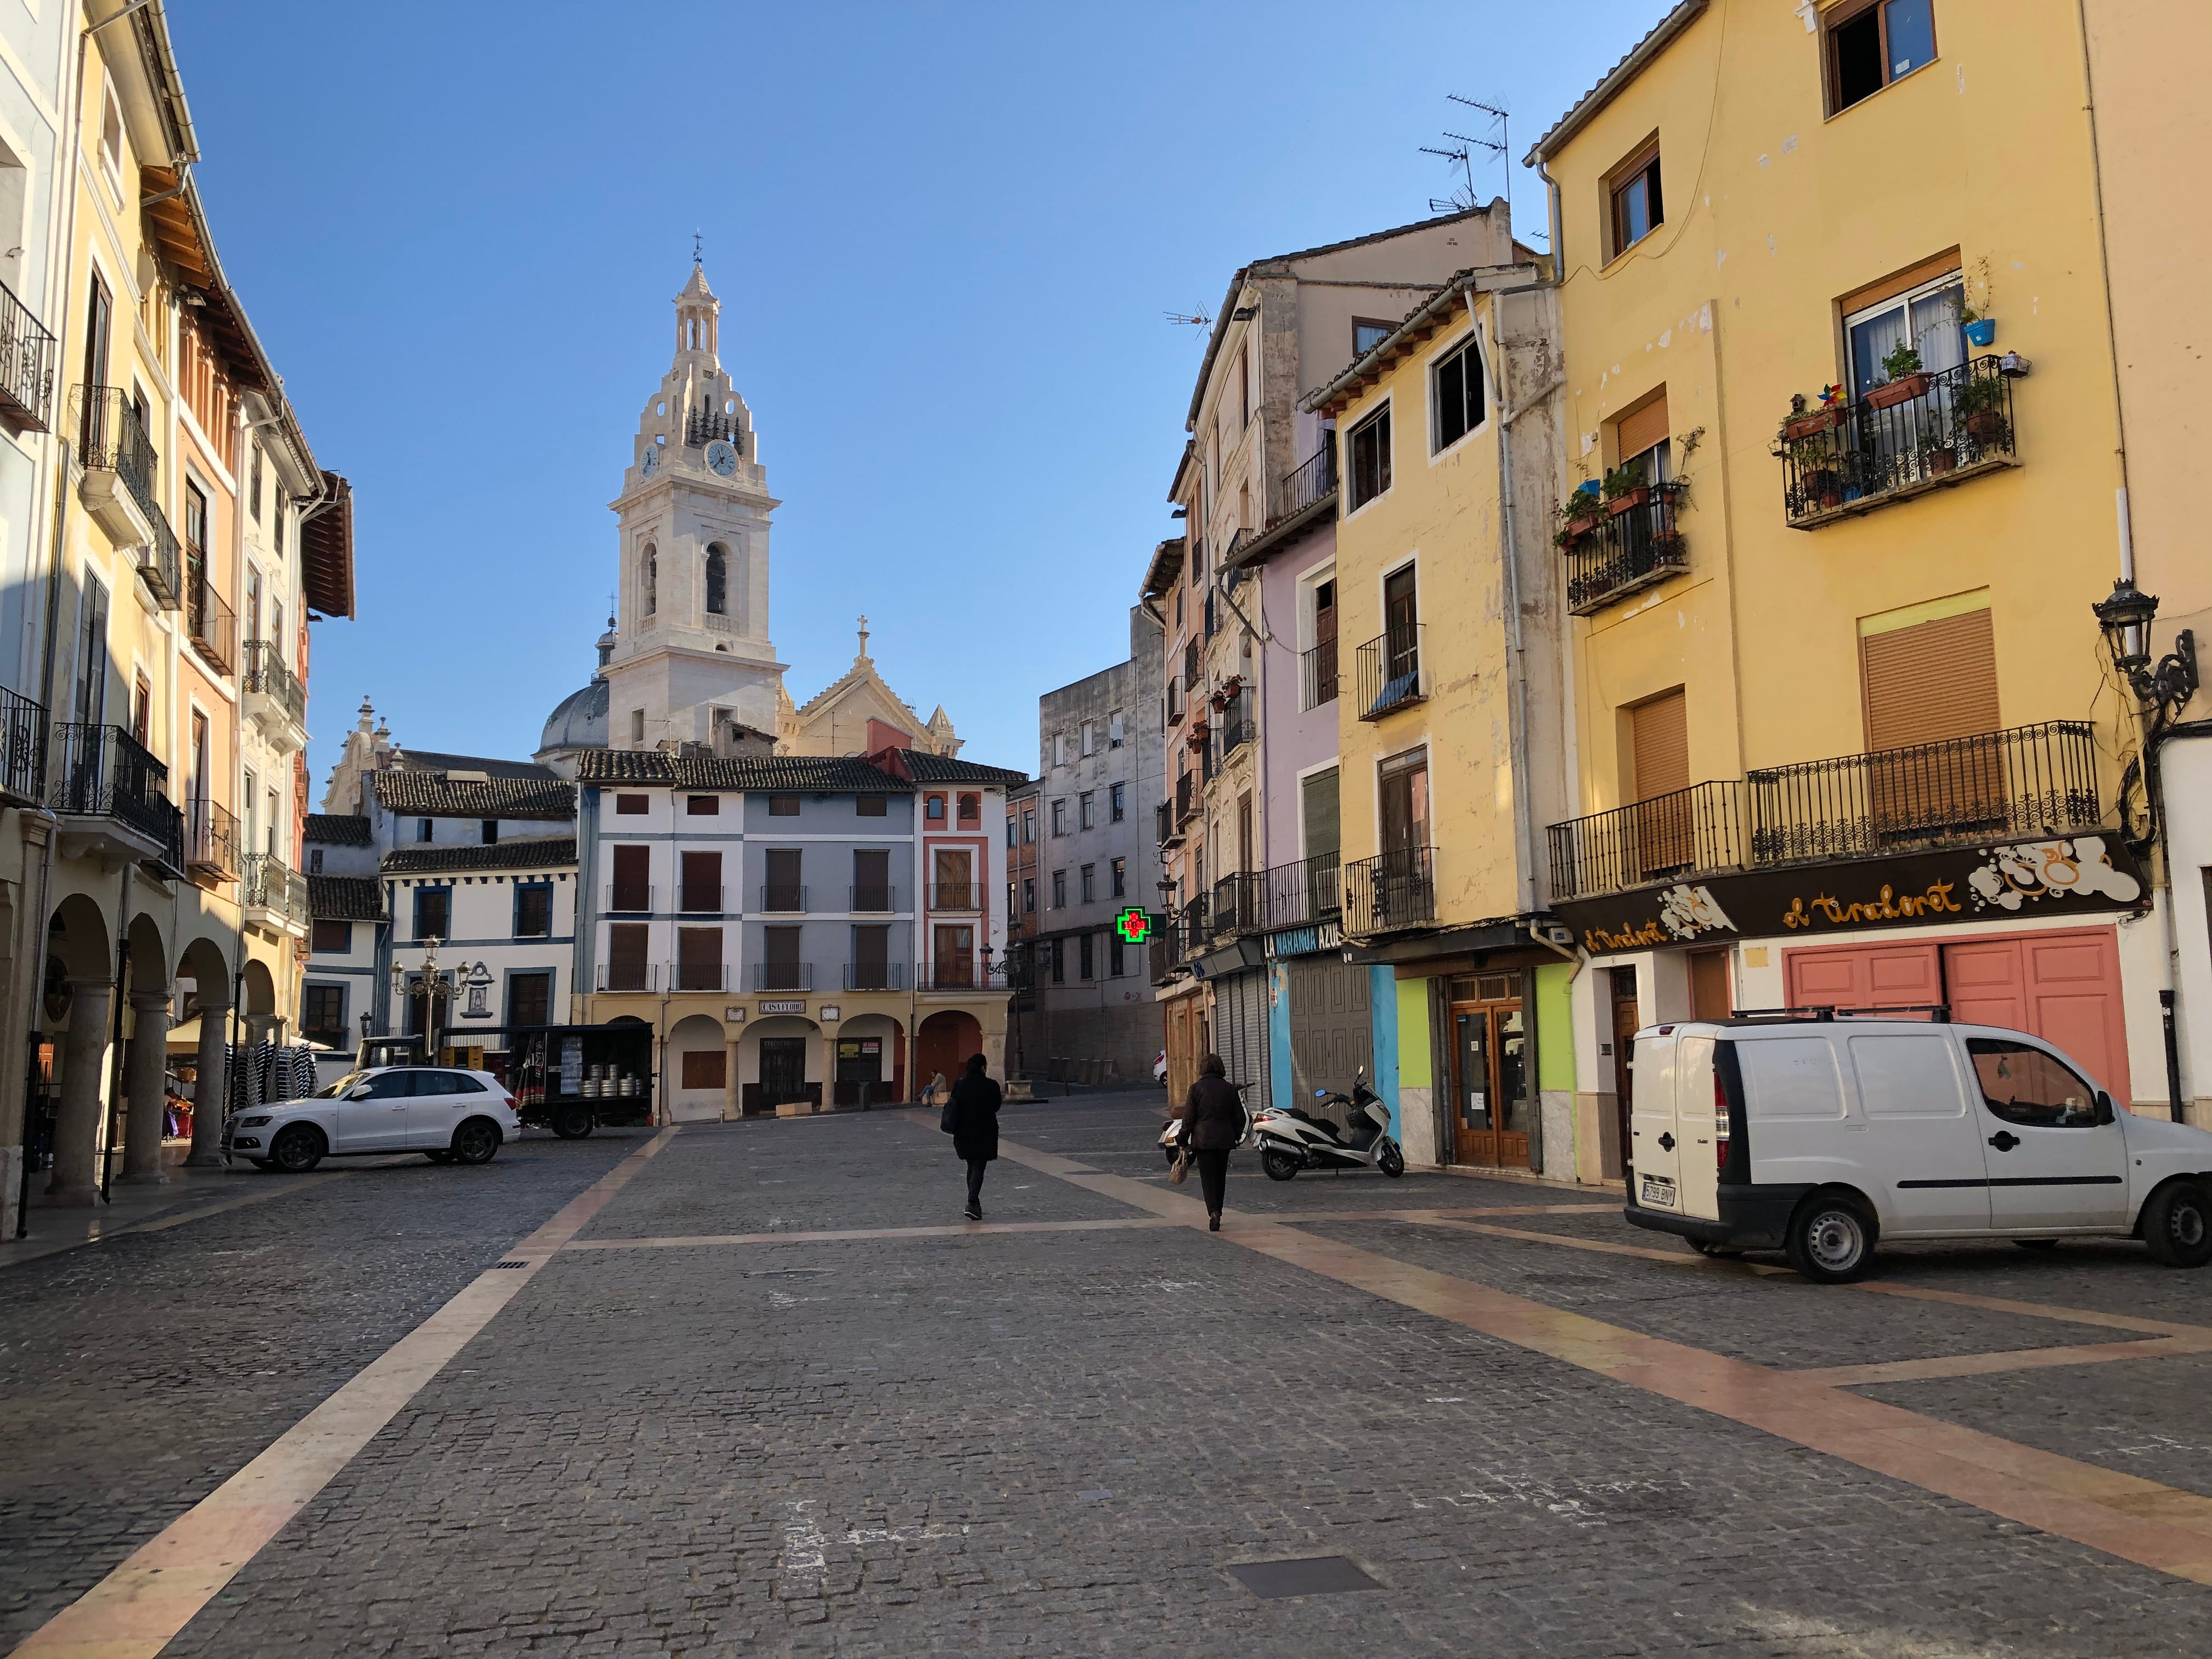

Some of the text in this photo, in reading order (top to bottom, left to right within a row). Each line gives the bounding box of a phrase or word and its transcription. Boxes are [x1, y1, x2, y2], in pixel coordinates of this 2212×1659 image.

[1783, 898, 1810, 928] el
[1264, 922, 1341, 957] LA NARANJA AZUL
